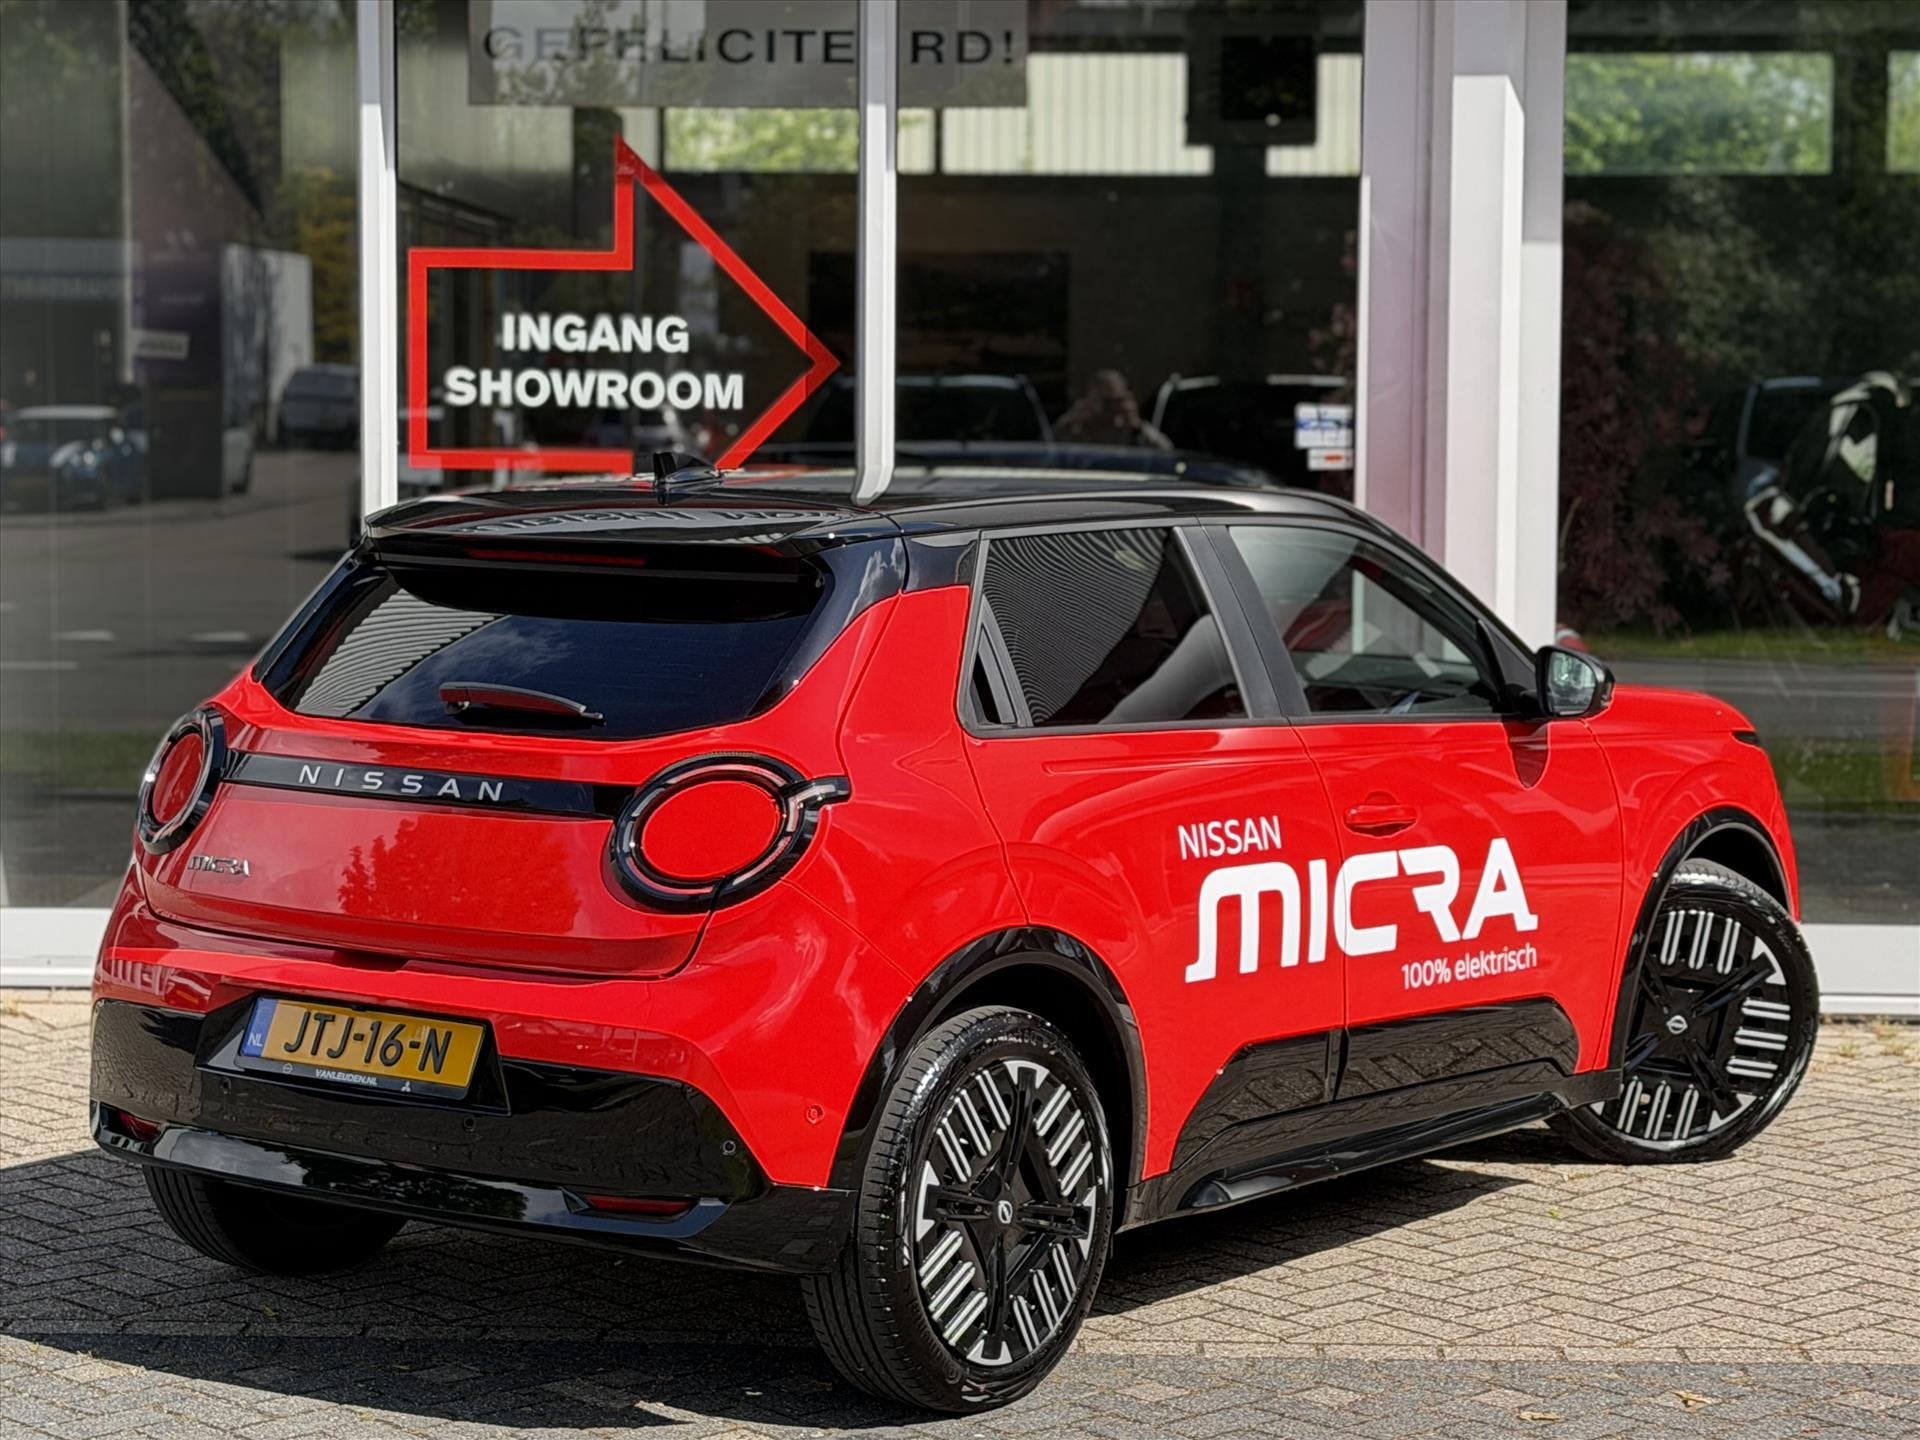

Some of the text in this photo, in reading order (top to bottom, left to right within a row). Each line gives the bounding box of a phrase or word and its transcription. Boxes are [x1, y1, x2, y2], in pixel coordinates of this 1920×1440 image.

[484, 27, 1015, 64] GEFELICITERD!
[501, 313, 690, 353] INGANG
[444, 365, 745, 410] SHOWROOM
[299, 764, 503, 802] NISSAN
[1177, 815, 1281, 860] NISSAN
[187, 855, 251, 878] MICRA
[1185, 837, 1539, 984] MICRA
[1401, 942, 1537, 990] 100% elektrisch
[247, 1010, 453, 1075] NL JTJ-16-N
[315, 1068, 378, 1087] VANLEUDEN.NL
